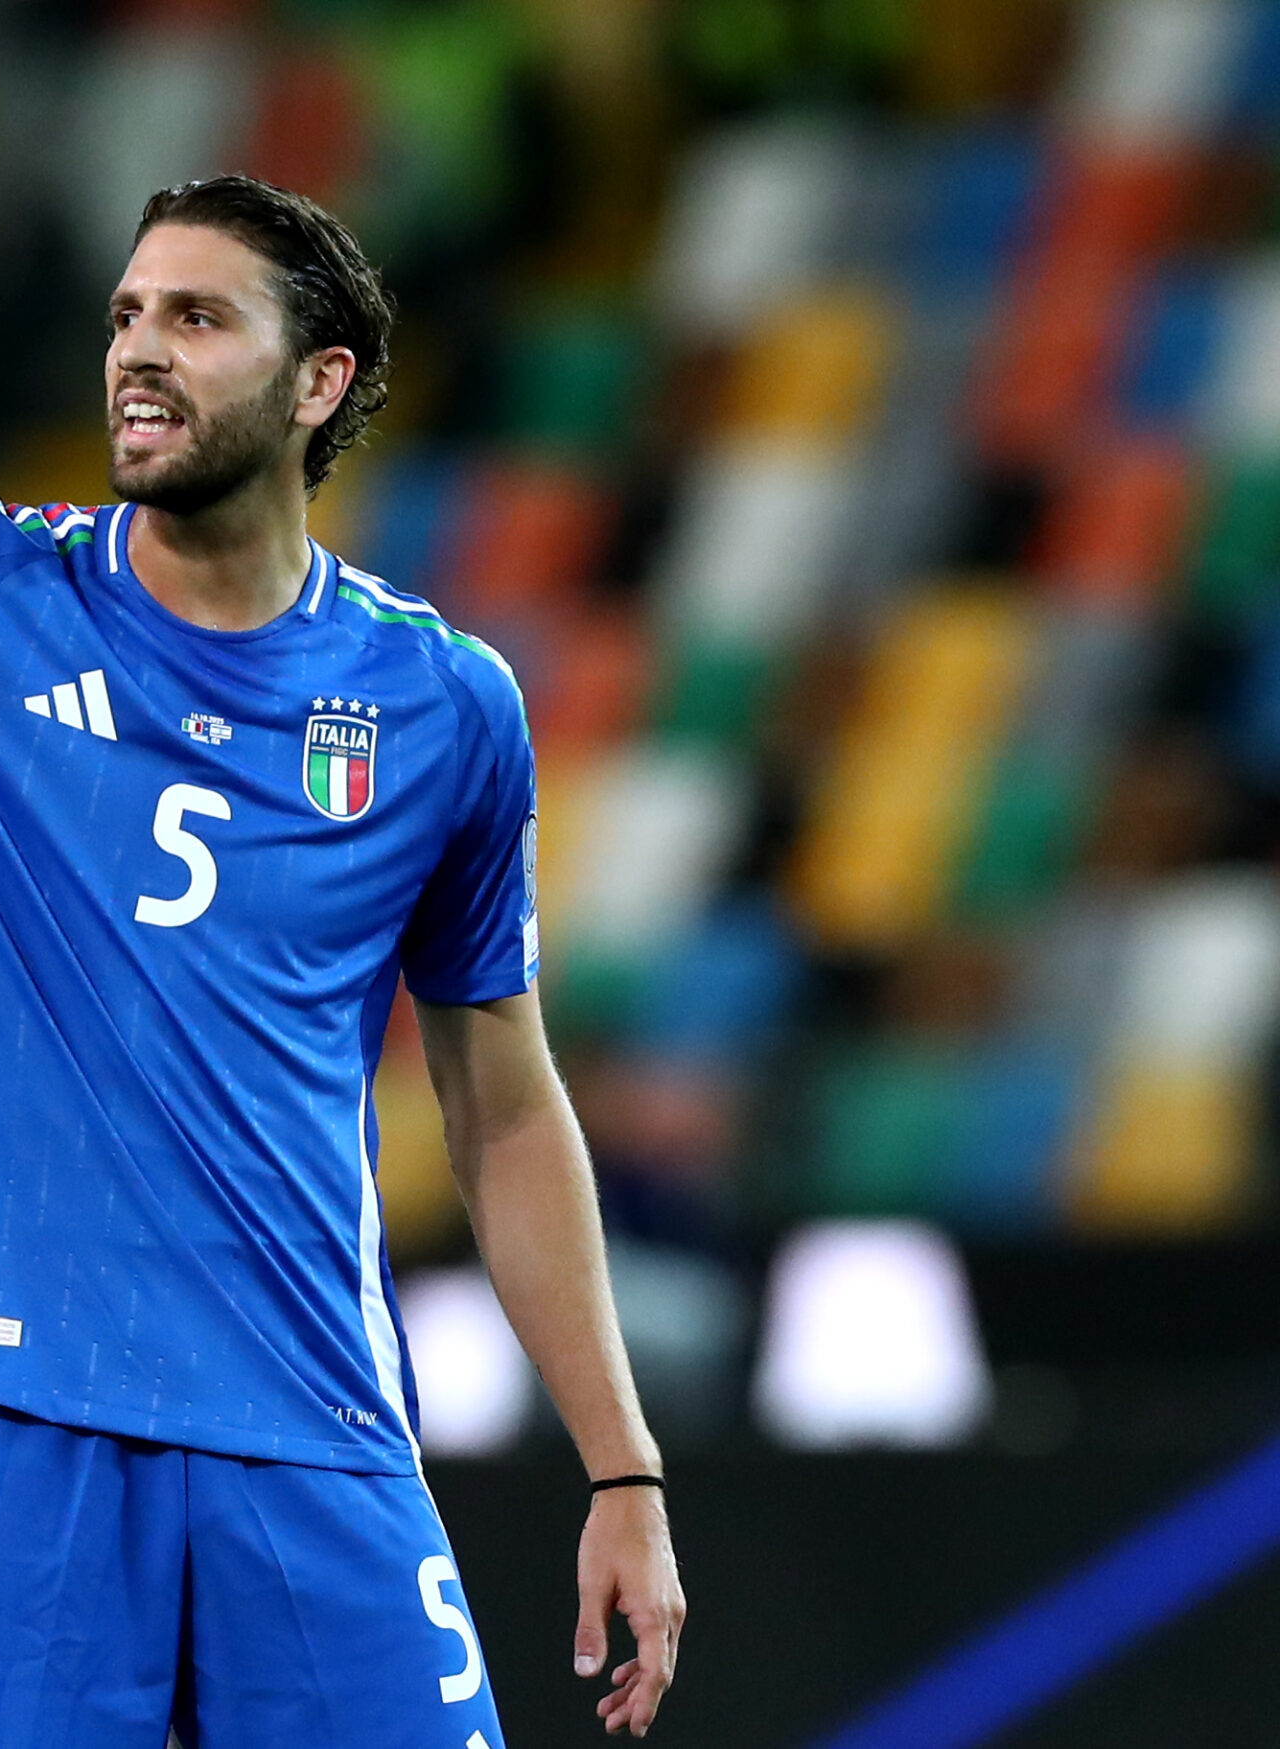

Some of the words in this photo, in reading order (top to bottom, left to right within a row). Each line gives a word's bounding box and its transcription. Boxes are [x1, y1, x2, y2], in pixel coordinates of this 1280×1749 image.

[311, 722, 369, 750] ITALIA
[134, 783, 232, 927] 5
[417, 1555, 482, 1704] 5
